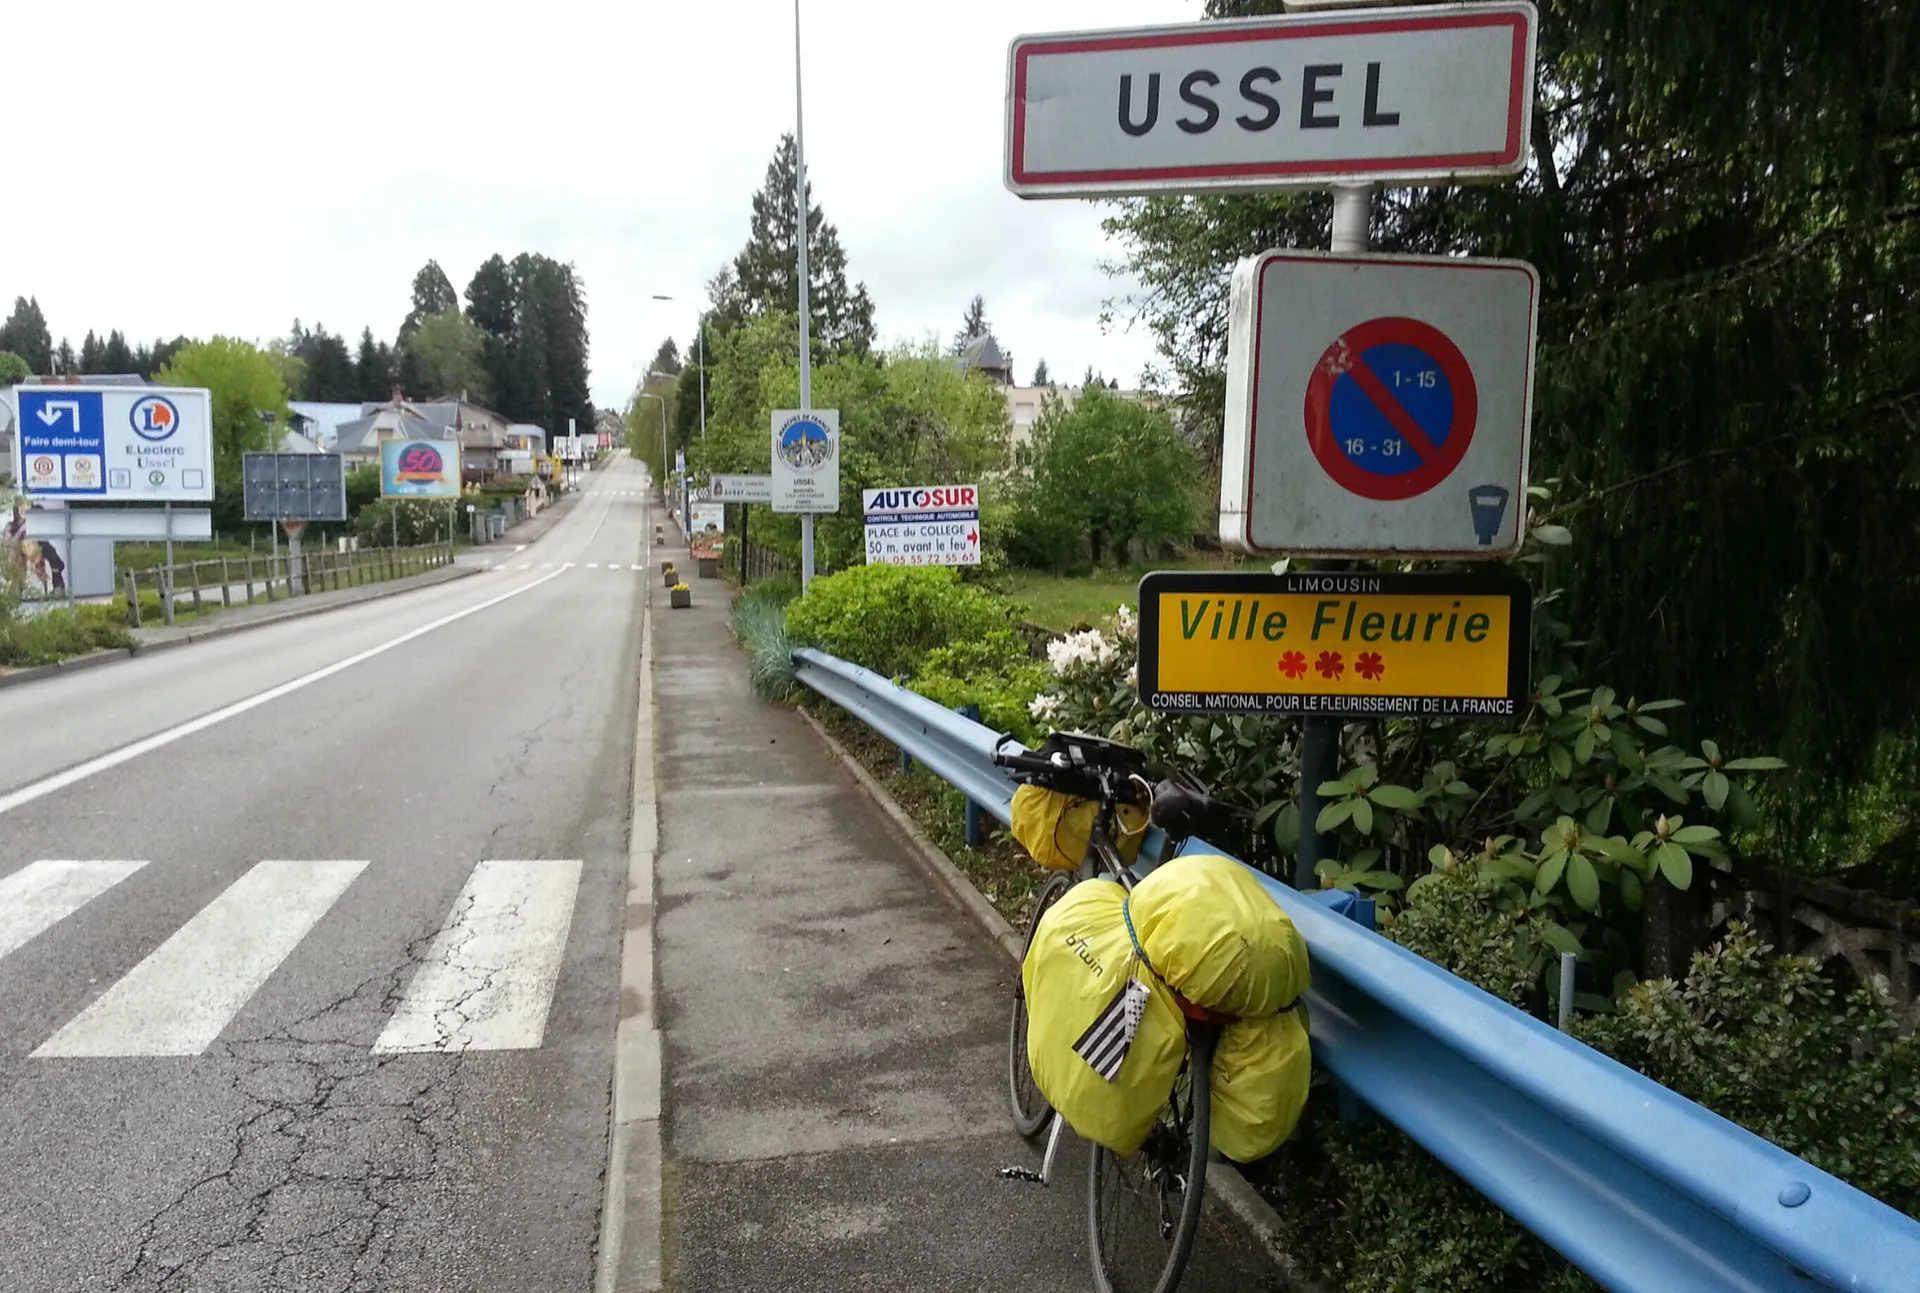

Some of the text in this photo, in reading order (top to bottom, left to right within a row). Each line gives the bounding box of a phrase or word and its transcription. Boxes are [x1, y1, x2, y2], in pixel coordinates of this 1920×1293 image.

[1117, 61, 1400, 137] USSEL
[24, 435, 100, 447] Faire demi-tour
[125, 445, 185, 456] E.Leclerc
[137, 457, 175, 469] Ussel
[868, 487, 974, 510] AUTOSUR
[901, 513, 935, 522] TECHNIQUE
[937, 511, 975, 520] AUTOMOBILE
[868, 525, 966, 538] PLACE du COLLEGE
[869, 537, 966, 554] 50 m. avant le feu
[893, 555, 906, 564] 05
[911, 554, 922, 564] 55
[927, 554, 940, 563] 72
[945, 553, 957, 562] 55
[962, 552, 975, 561] 65
[1287, 577, 1381, 593] LIMOUSIN
[1180, 600, 1490, 642] Ville Fleurie
[1151, 693, 1514, 714] CONSEIL NATIONAL POUR LE FLEURISSEMENT DE LA FRANCE
